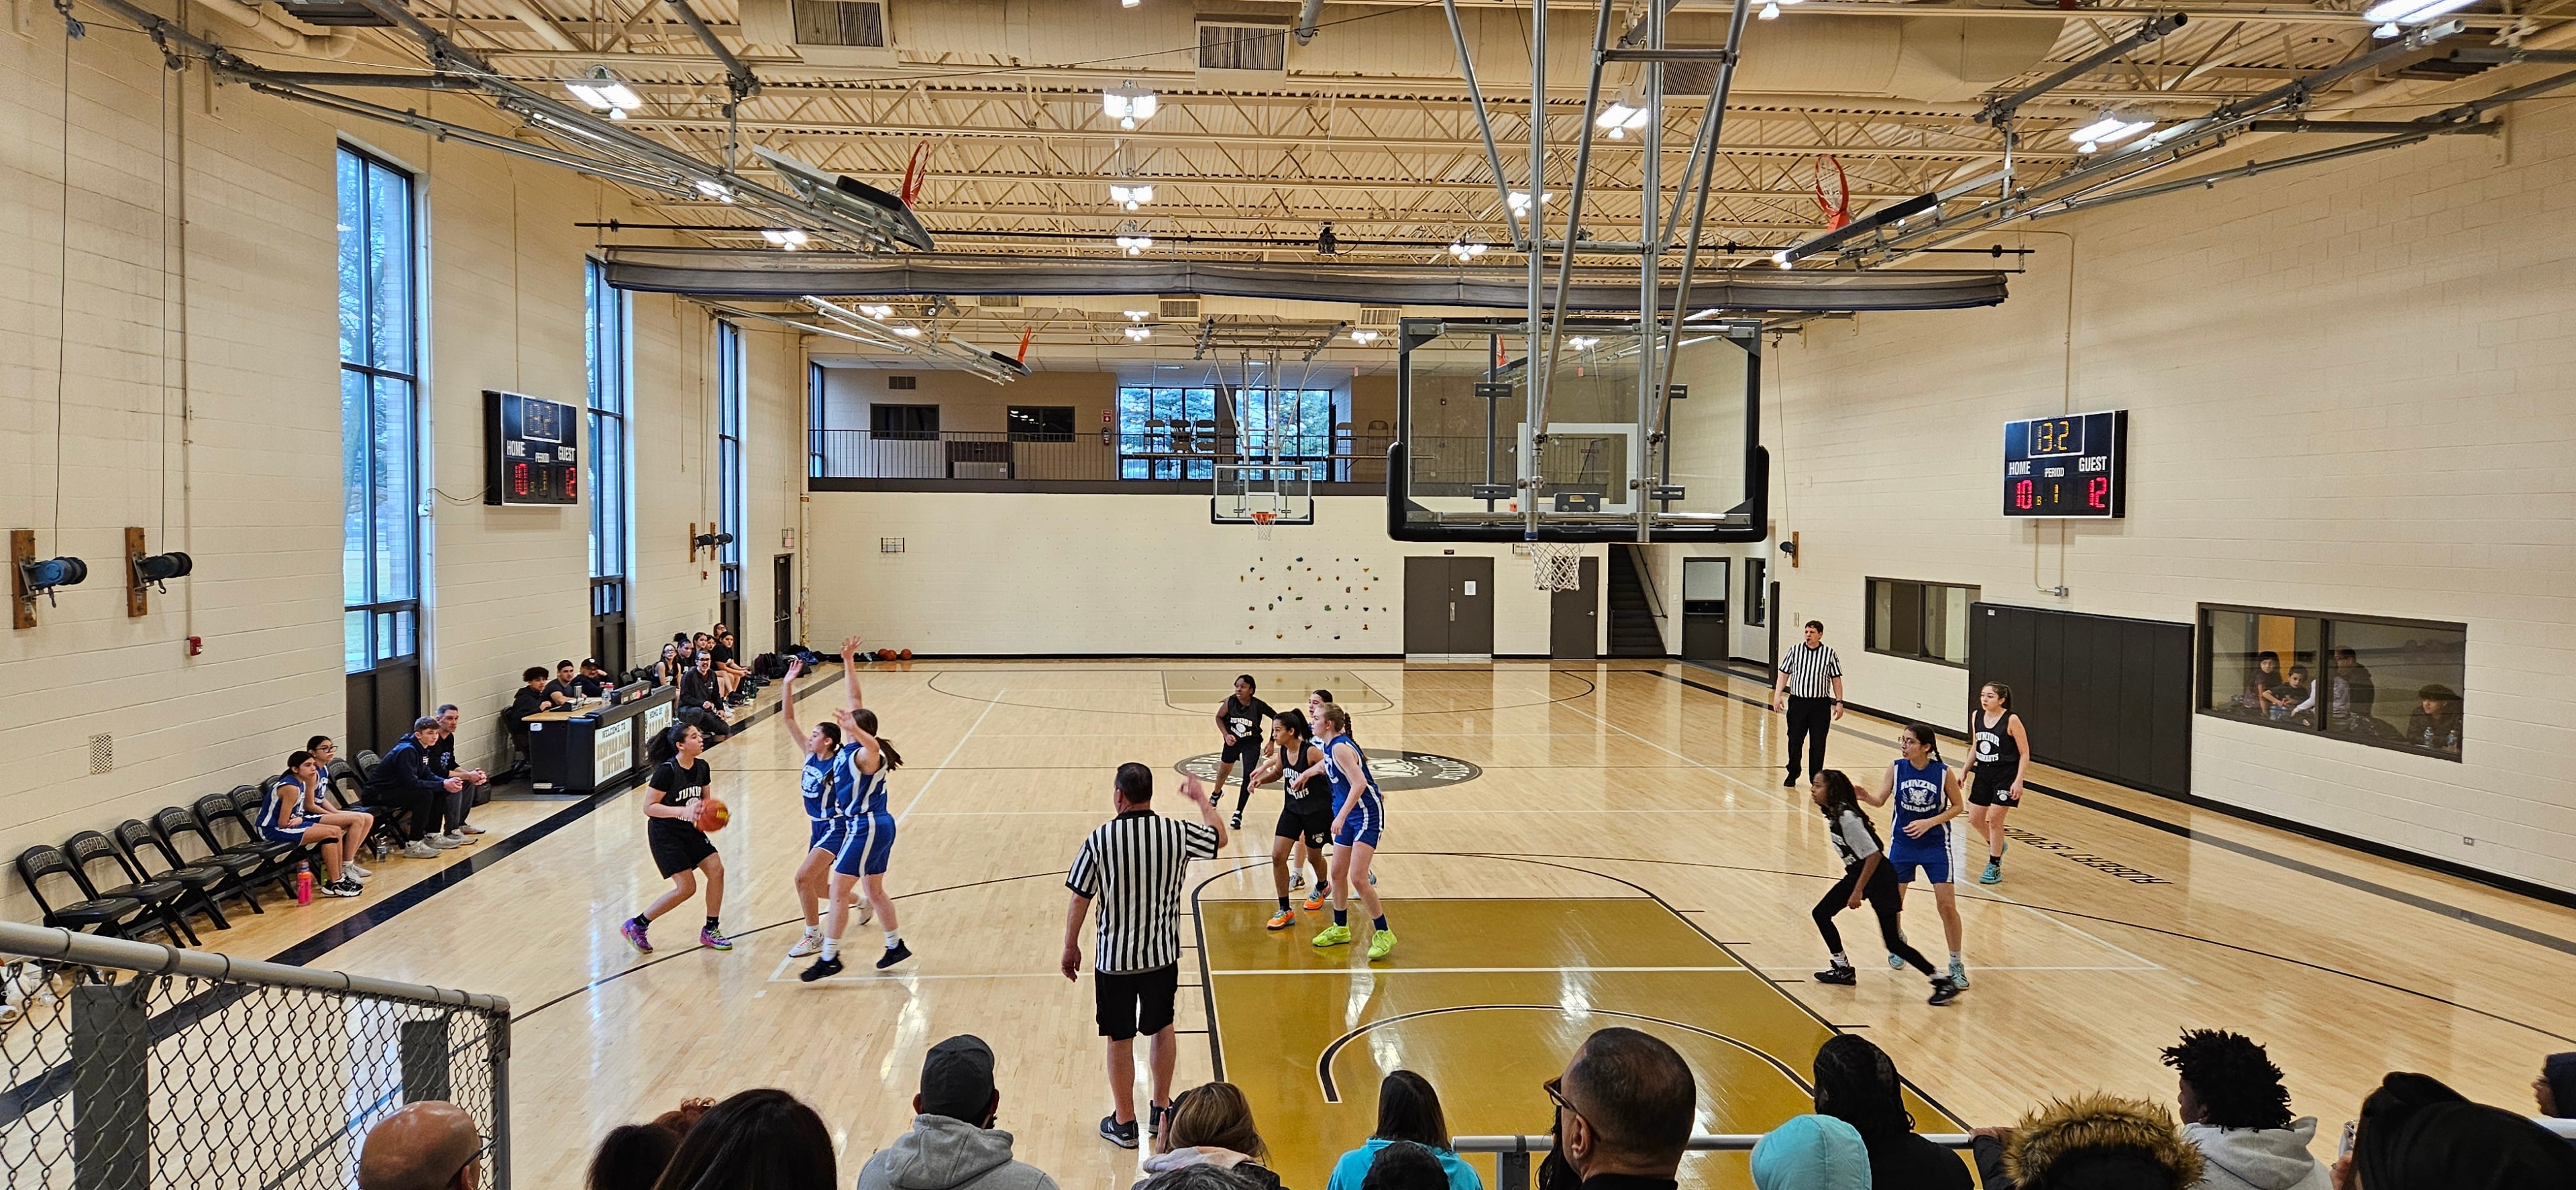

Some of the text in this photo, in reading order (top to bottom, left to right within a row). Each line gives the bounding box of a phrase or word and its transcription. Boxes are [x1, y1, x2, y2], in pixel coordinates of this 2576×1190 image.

[506, 440, 526, 457] HOME
[558, 445, 576, 462] GUEST
[2008, 461, 2031, 476] HOME
[2044, 467, 2065, 478] PERIOD
[2078, 456, 2108, 472] GUEST
[2015, 480, 2033, 509] 10
[2053, 484, 2059, 504] 1
[2088, 476, 2108, 508] 12
[1230, 717, 1253, 727] JUNIOR
[602, 724, 621, 739] WELCOME
[1411, 755, 1470, 781] BULLDOGS
[1900, 779, 1937, 794] KINZIE
[202, 798, 233, 817] BEDFORD
[1900, 800, 1937, 813] COUGARS
[74, 836, 109, 858] BEDFORD
[27, 850, 62, 873] BEDFORD
[2054, 852, 2174, 885] ROBERT
